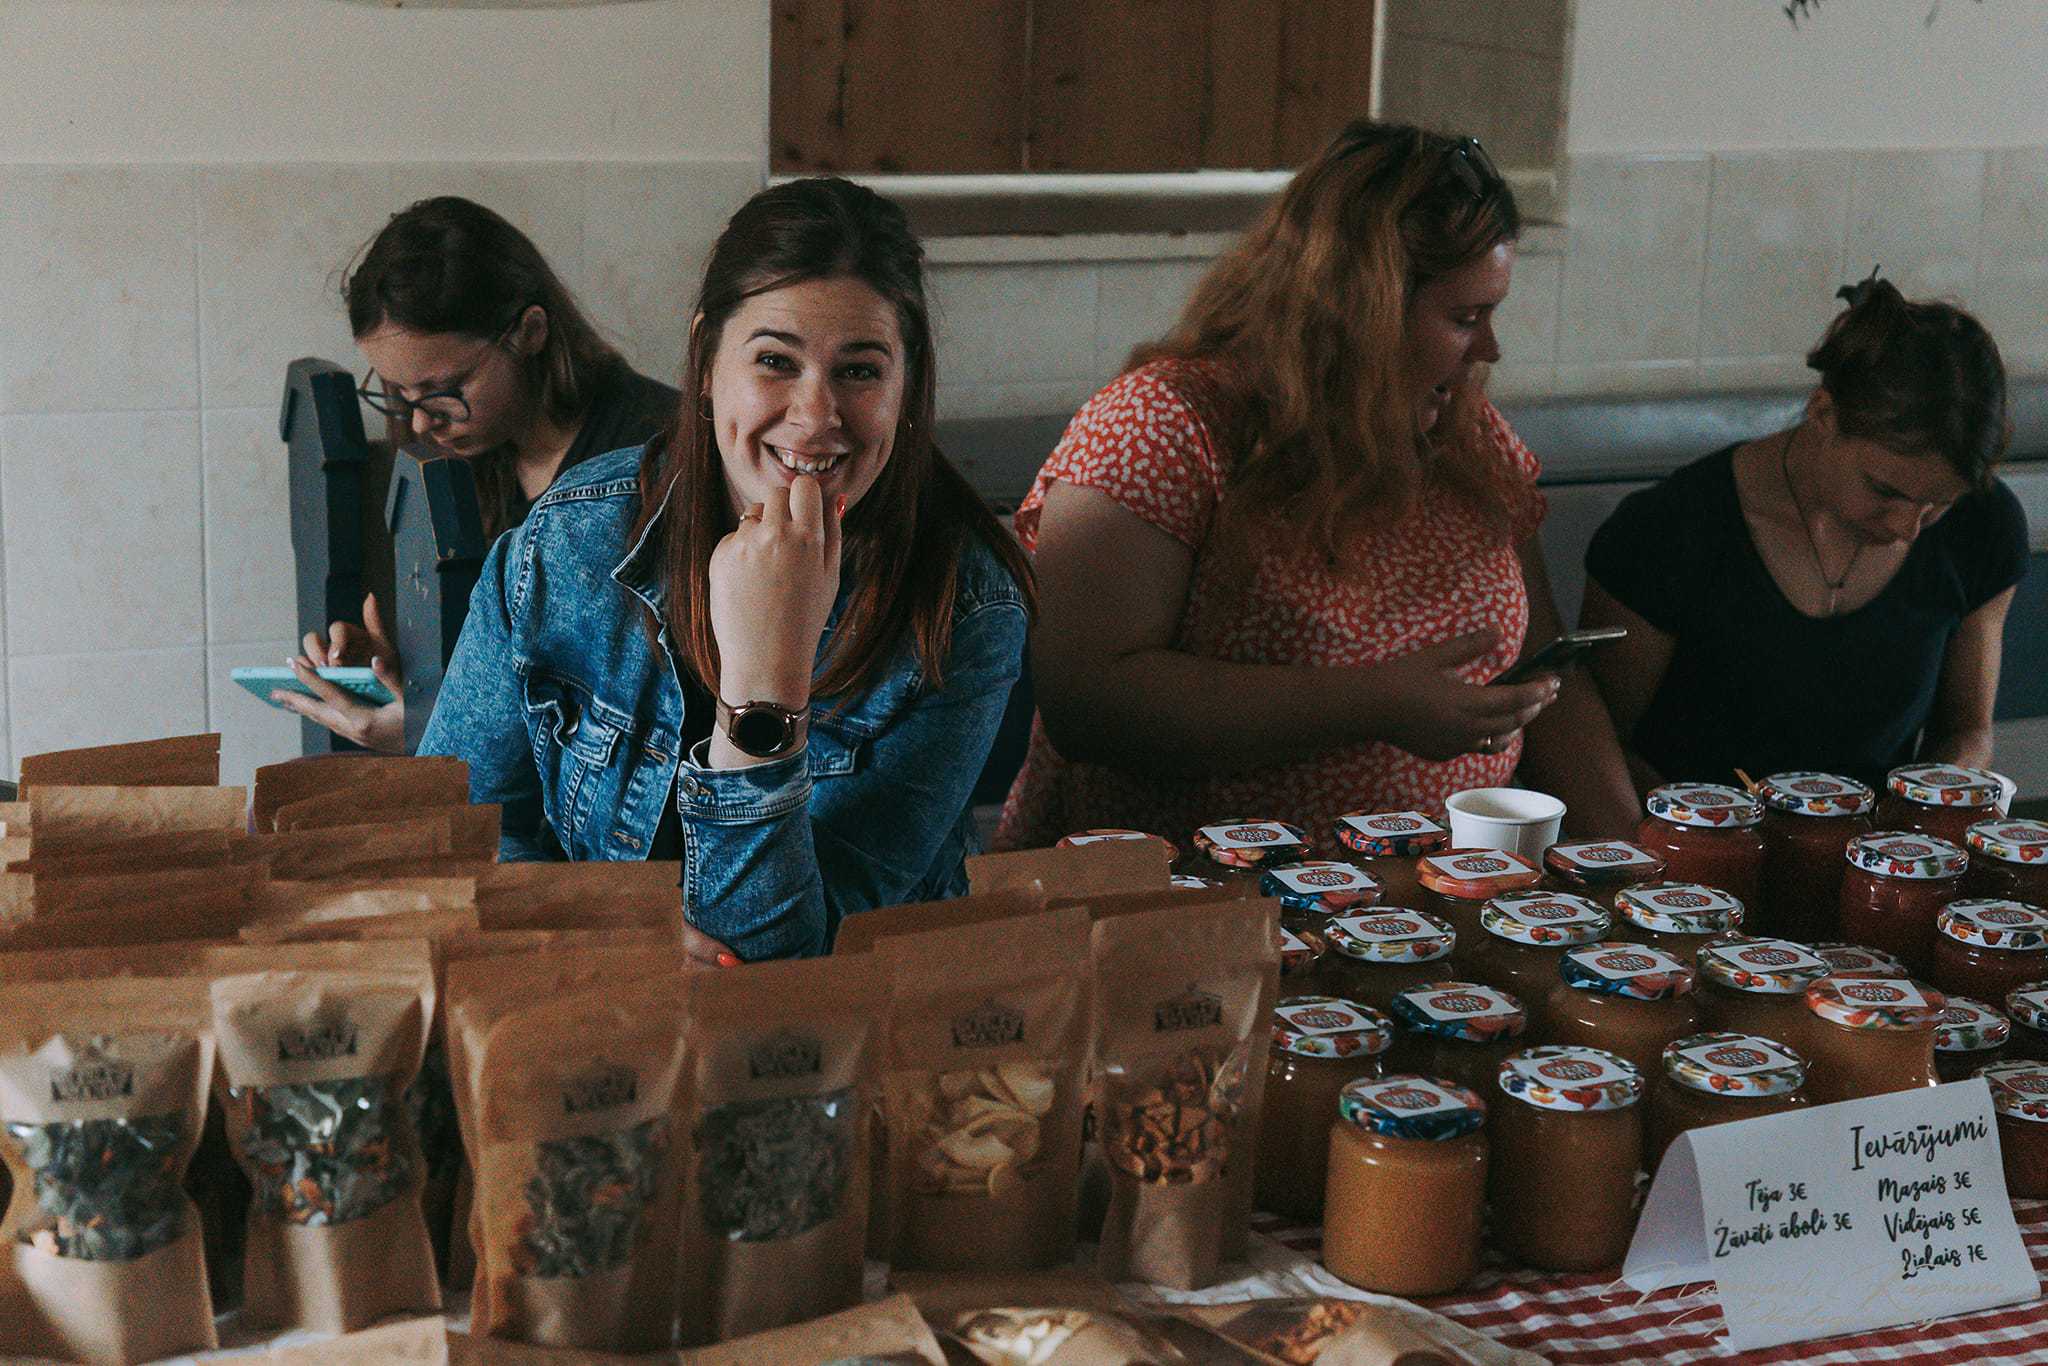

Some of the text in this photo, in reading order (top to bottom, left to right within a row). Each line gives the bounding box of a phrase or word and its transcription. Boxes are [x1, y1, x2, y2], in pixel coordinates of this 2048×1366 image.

[1850, 1115, 1988, 1171] Ievārījumi
[1745, 1179, 1807, 1213] Tēja 3€
[1878, 1172, 1972, 1203] Mazais 3€
[1780, 1208, 1828, 1238] āboli
[1833, 1213, 1853, 1231] 3€
[1884, 1207, 1982, 1242] Vidējais 5€
[1901, 1244, 1988, 1280] Lielais 7€
